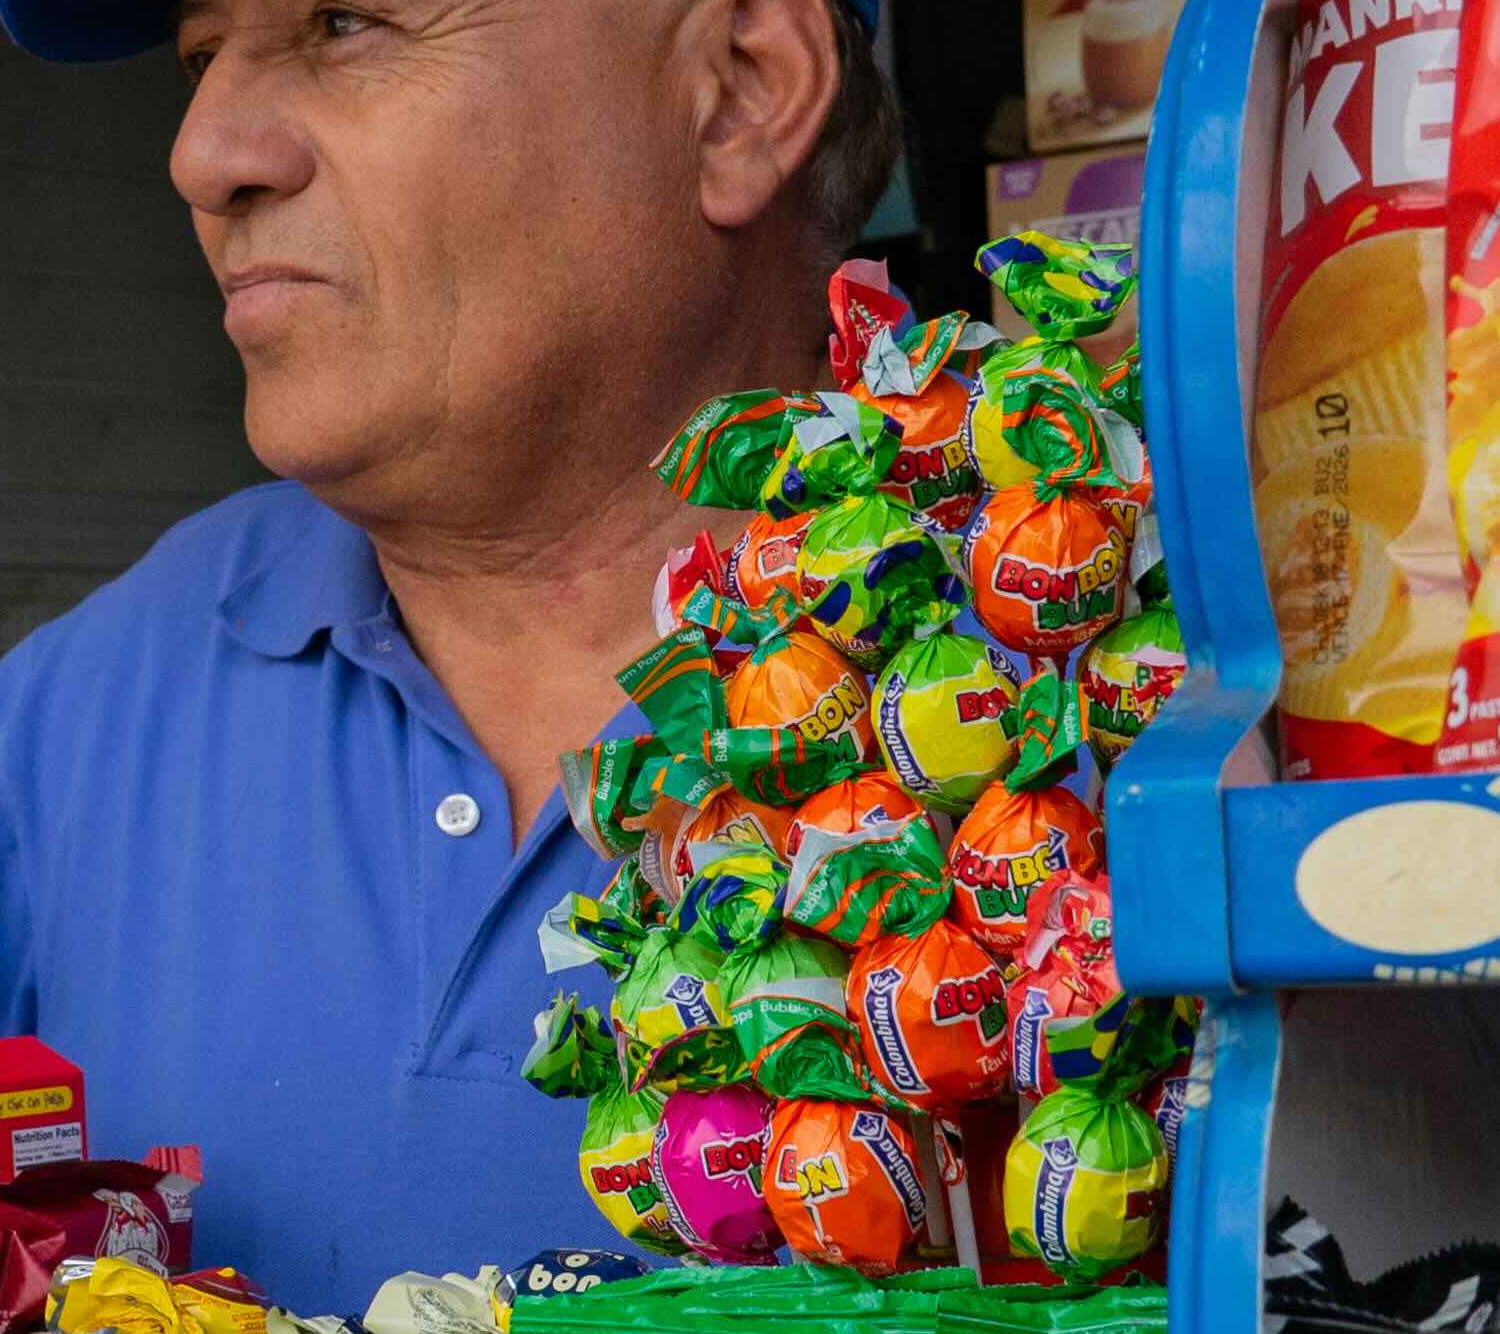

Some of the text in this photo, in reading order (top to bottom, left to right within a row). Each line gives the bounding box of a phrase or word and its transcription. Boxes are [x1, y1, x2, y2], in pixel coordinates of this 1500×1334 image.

[1280, 27, 1457, 237] KE
[1446, 669, 1469, 728] 3
[14, 1126, 80, 1144] Nutrition Facts
[1036, 1163, 1072, 1265] Colombina
